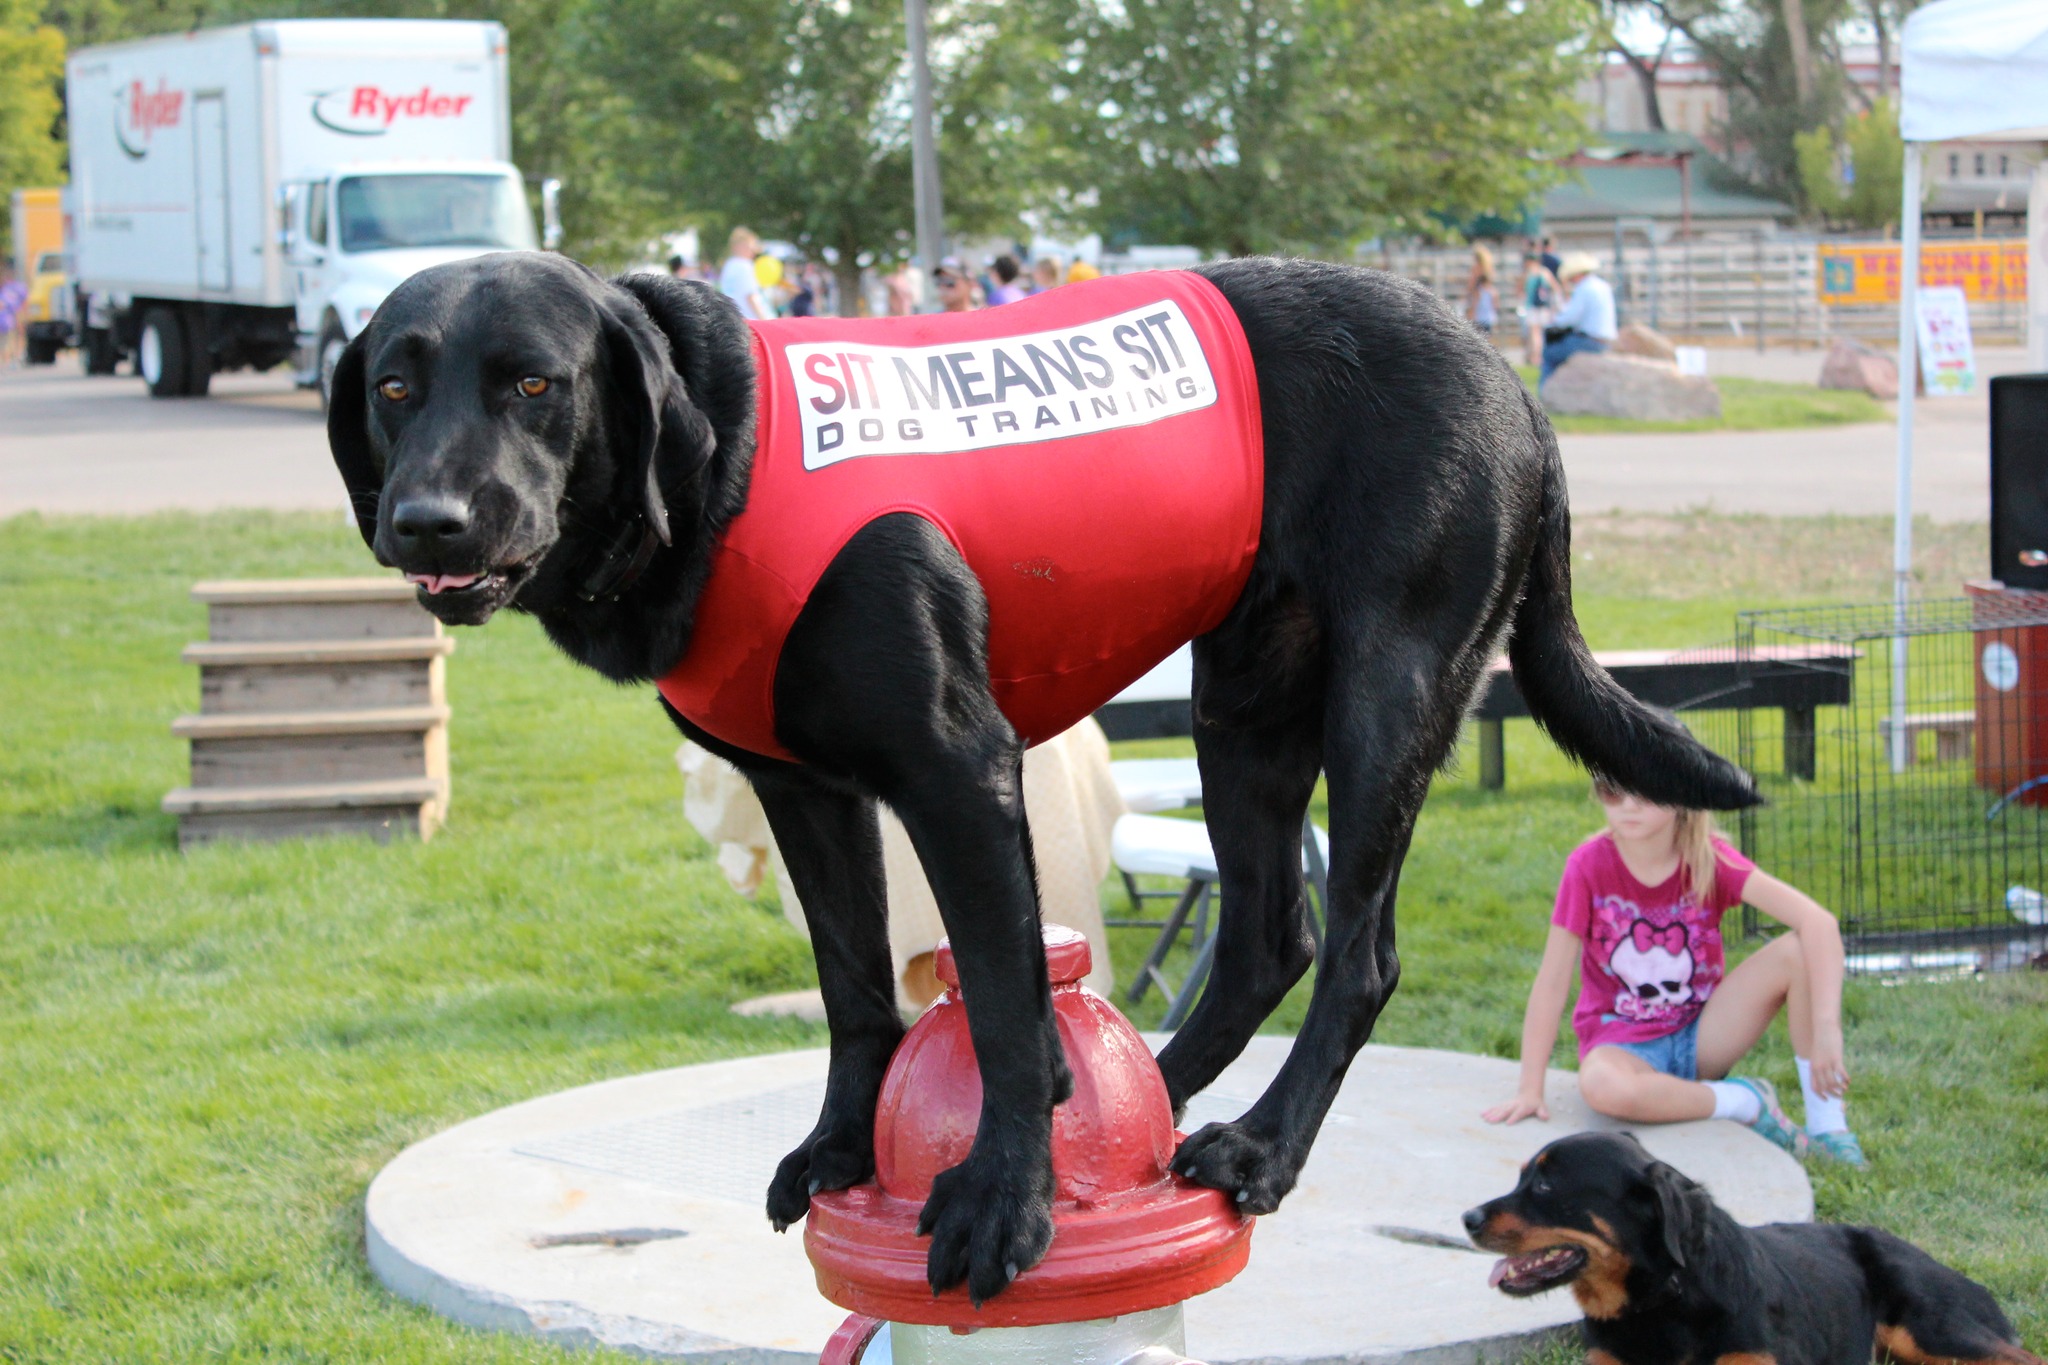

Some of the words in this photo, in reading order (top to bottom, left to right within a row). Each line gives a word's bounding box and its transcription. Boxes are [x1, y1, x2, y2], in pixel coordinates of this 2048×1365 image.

[130, 77, 184, 142] Ryder
[351, 86, 472, 127] Ryder
[804, 353, 881, 414] SIT
[891, 335, 1114, 410] MEANS
[1112, 311, 1187, 380] SIT
[817, 418, 924, 453] DOG
[956, 376, 1197, 437] TRAINING
